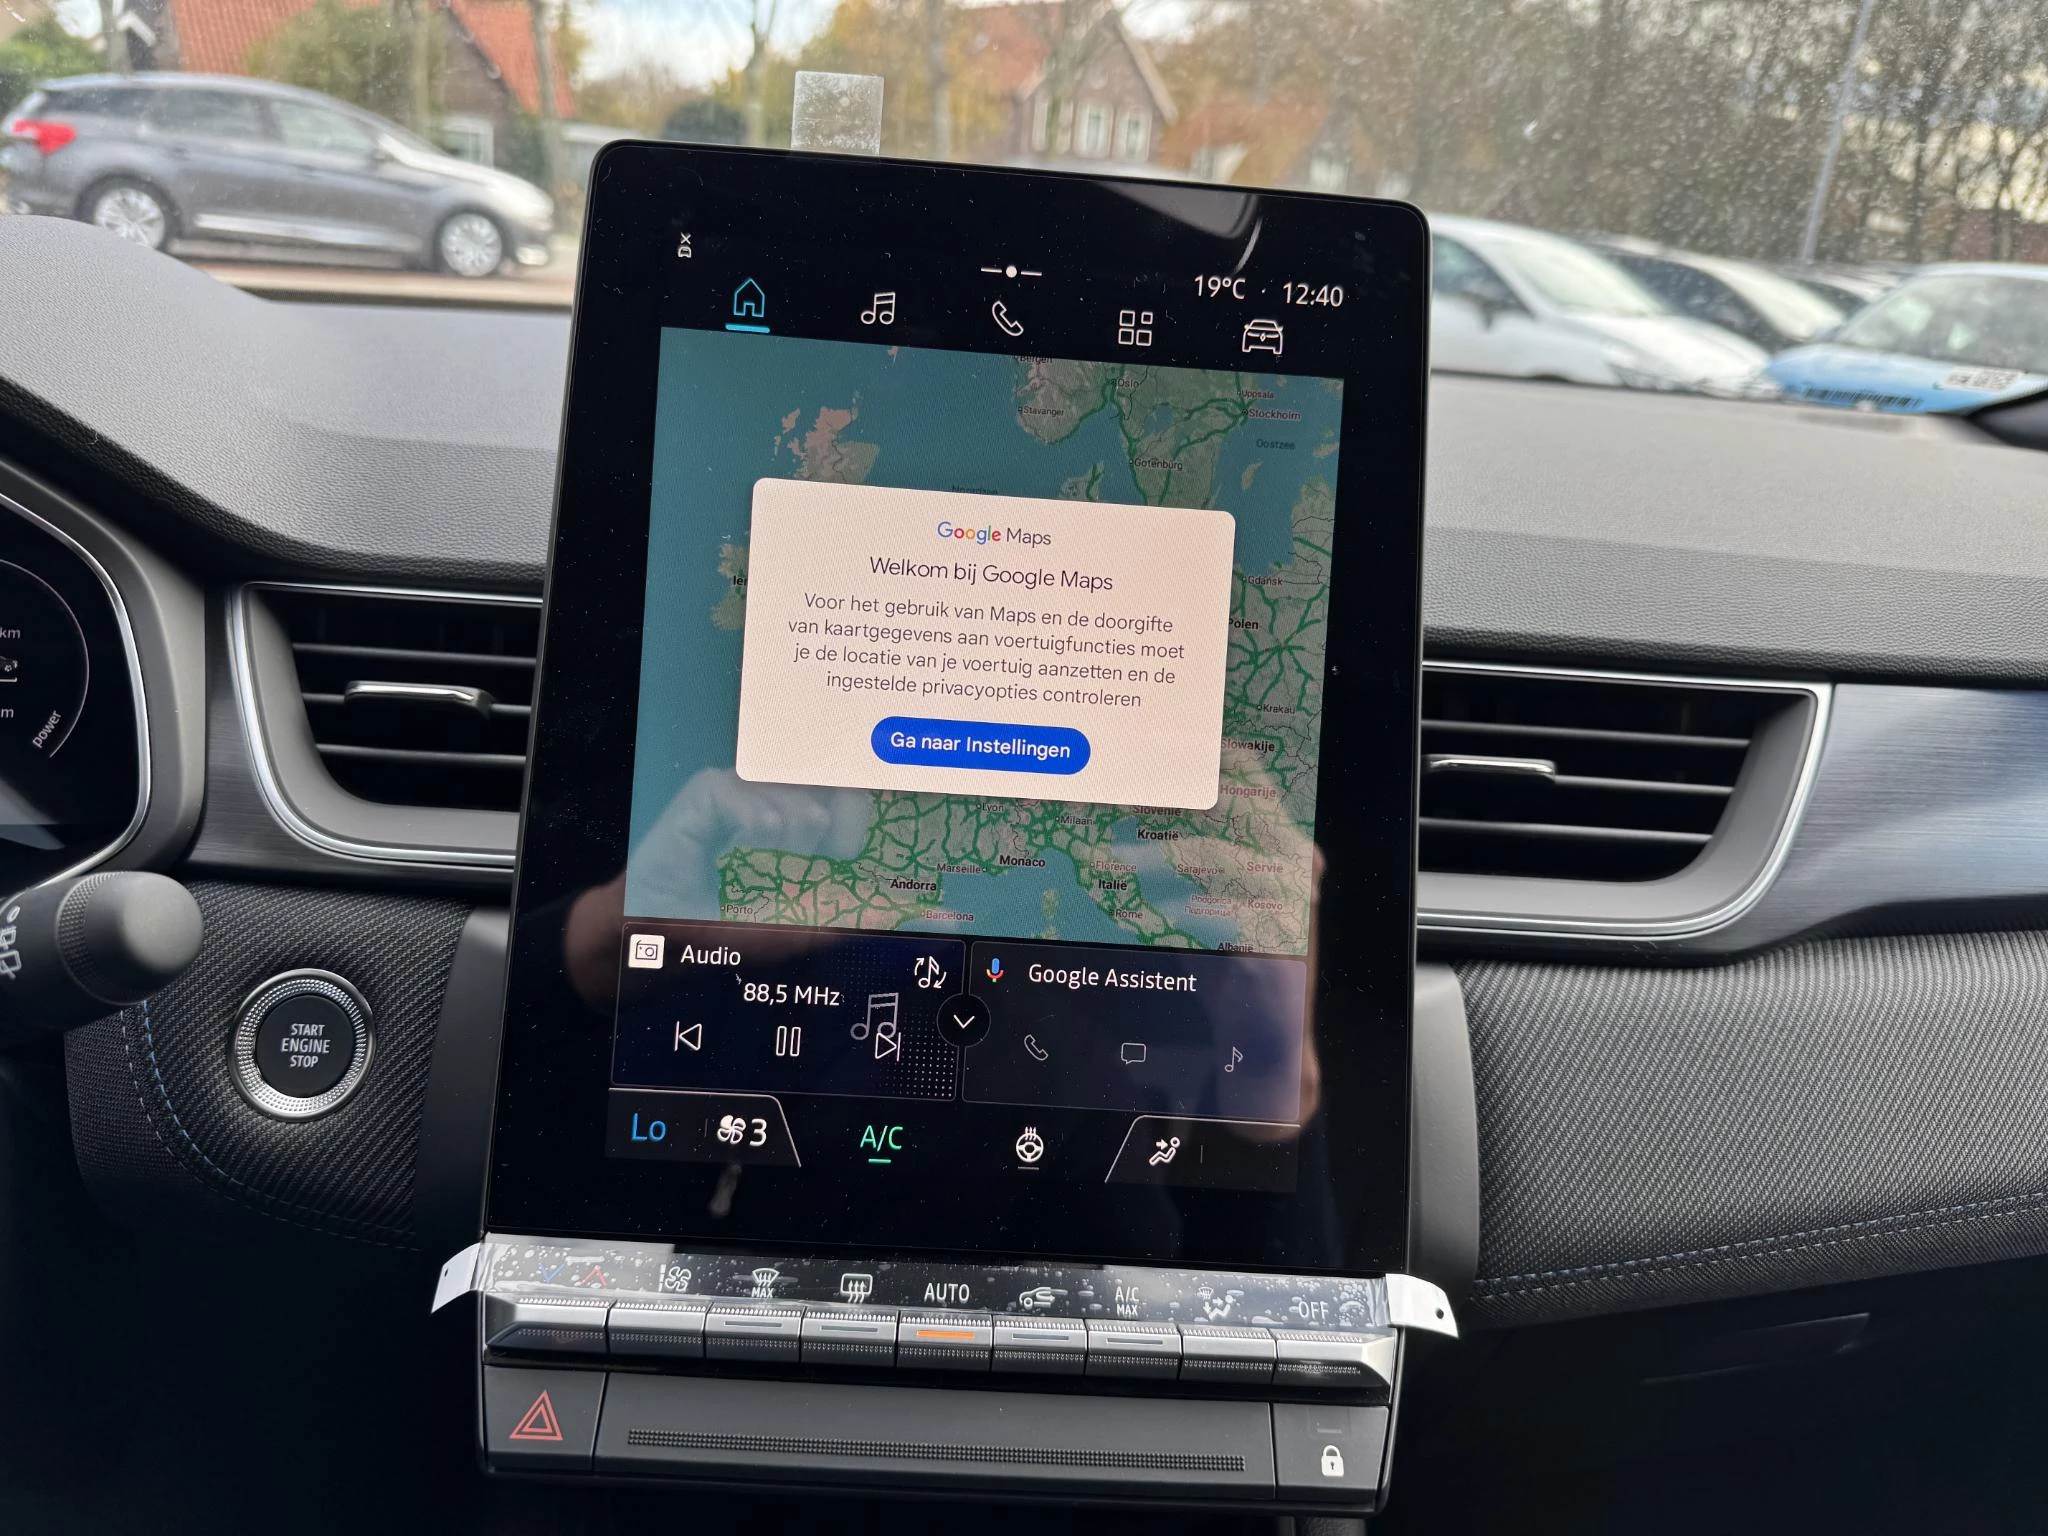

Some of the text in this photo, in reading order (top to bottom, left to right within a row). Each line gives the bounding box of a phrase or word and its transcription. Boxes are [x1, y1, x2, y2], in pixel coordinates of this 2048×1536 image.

[1283, 281, 1344, 307] 12:40
[1117, 377, 1140, 389] Oslo
[1241, 389, 1274, 401] Uppsala
[1022, 406, 1065, 417] Stavanger
[1249, 408, 1300, 421] Stockholm
[1256, 438, 1296, 451] Oostzee
[1134, 457, 1183, 471] Gotenburg
[937, 521, 1052, 547] Google Maps
[870, 556, 1113, 592] Welkom bij Google Maps
[1248, 575, 1283, 587] Gdańsk
[804, 592, 1174, 634] Voor het gebruik van Maps en de doorgifte
[788, 618, 1185, 660] van kaartgegevens aan voertuigfuncties moet
[794, 642, 1176, 686] je de locatie van je voertuig aanzetten en de
[827, 670, 1142, 708] ingestelde privacyopties controleren
[1263, 702, 1296, 715] Krakau
[32, 710, 62, 748] power
[890, 730, 1072, 761] Ga naar Instellingen
[1221, 739, 1275, 753] Slowakije
[1220, 784, 1277, 799] Hongarije
[982, 803, 1004, 814] Lyon
[1060, 815, 1093, 827] Milaan
[1137, 829, 1179, 841] Kroatië
[937, 863, 981, 875] Marseille
[999, 855, 1046, 869] Monaco
[1095, 860, 1137, 873] Florence
[1177, 863, 1217, 875] Sarajevo
[1247, 861, 1284, 874] Servië
[890, 878, 937, 892] Andorra
[1098, 878, 1128, 892] Italië
[726, 904, 754, 916] Porto
[1248, 899, 1283, 911] Kosovo
[926, 909, 975, 922] Barcelona
[1115, 909, 1144, 920] Rome
[681, 945, 741, 966] Audio
[1028, 964, 1197, 992] Google Assistent
[743, 983, 841, 1006] 88,5 MHz
[290, 1023, 325, 1036] START
[281, 1037, 330, 1054] ENGINE
[289, 1055, 319, 1068] STOP
[631, 1112, 667, 1142] Lo
[749, 1117, 767, 1147] 3
[860, 1125, 904, 1151] A/C
[752, 1287, 774, 1298] MAX
[924, 1282, 970, 1304] AUTO
[1115, 1285, 1140, 1302] A/C
[1116, 1303, 1139, 1316] MAX
[1298, 1301, 1329, 1320] OFF
